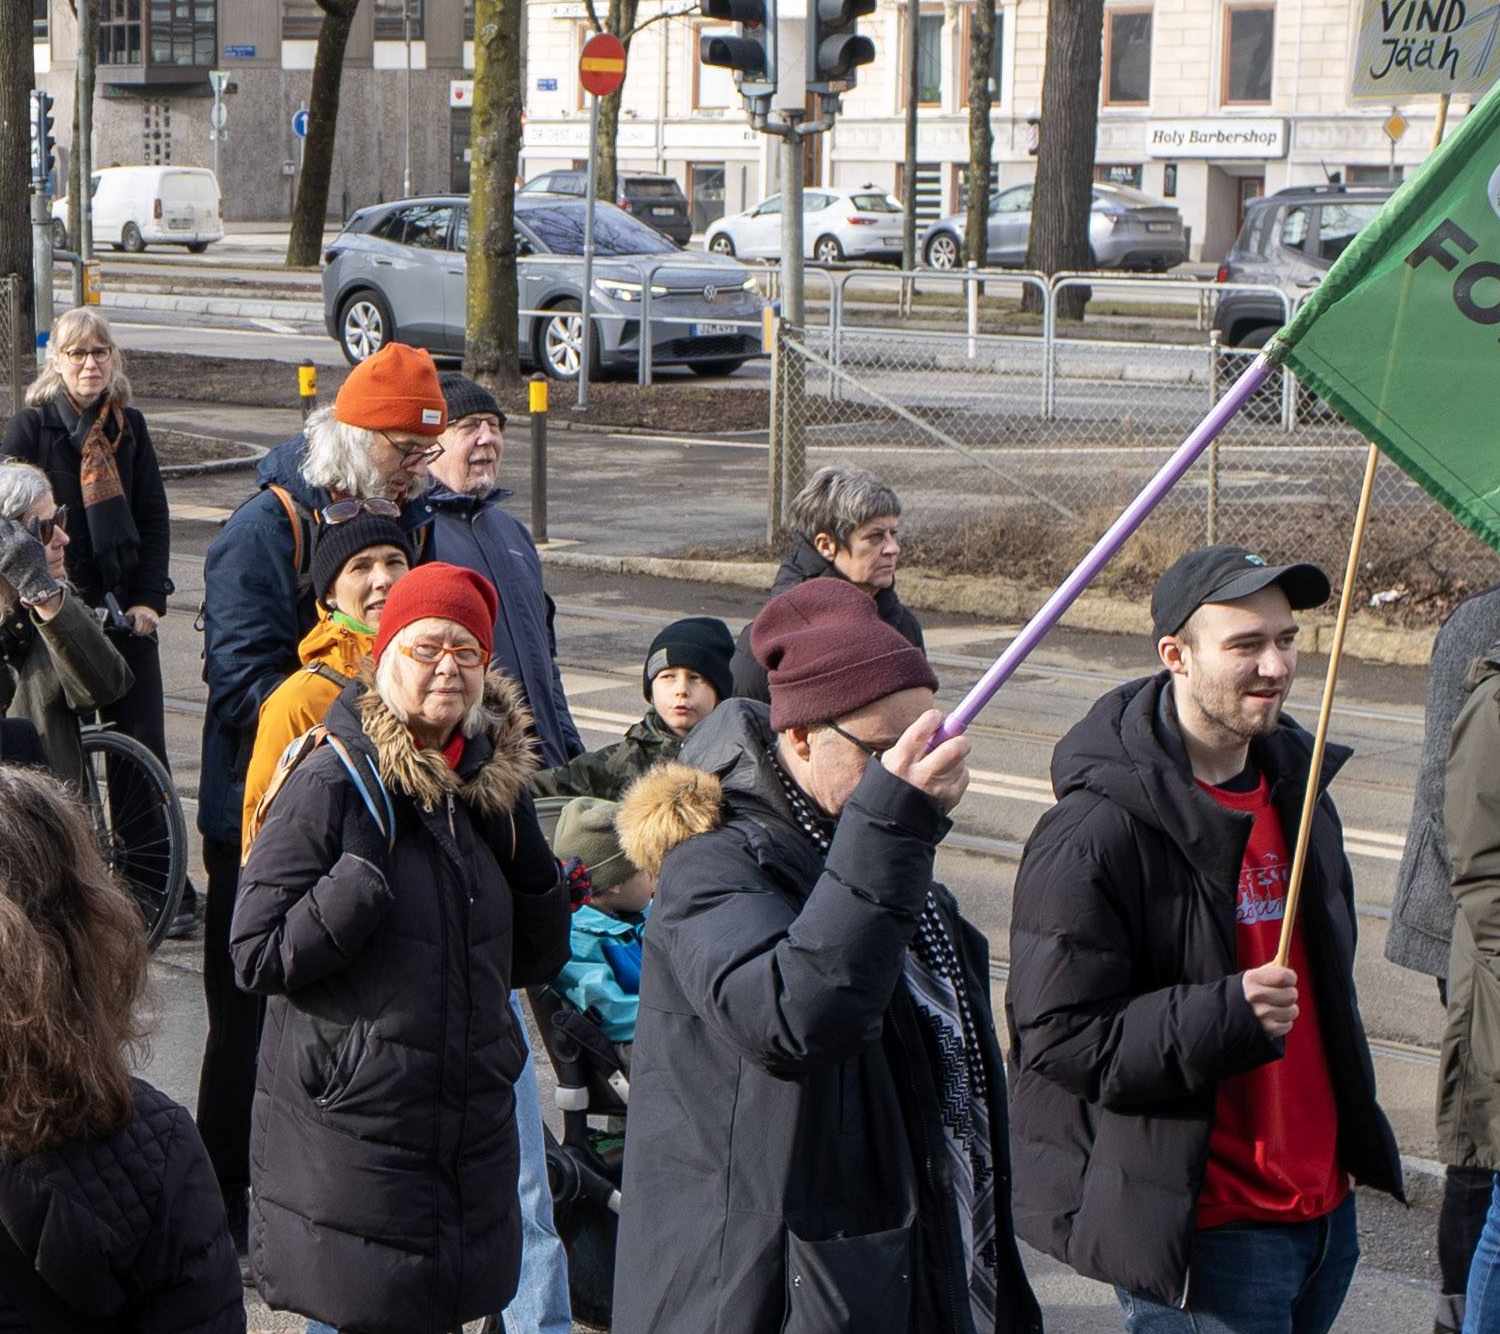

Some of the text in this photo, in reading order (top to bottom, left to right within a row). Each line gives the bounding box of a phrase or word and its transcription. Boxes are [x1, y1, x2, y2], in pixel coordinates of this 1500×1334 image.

[1369, 35, 1460, 80] Jääh
[1152, 128, 1278, 147] Holy Barbershop
